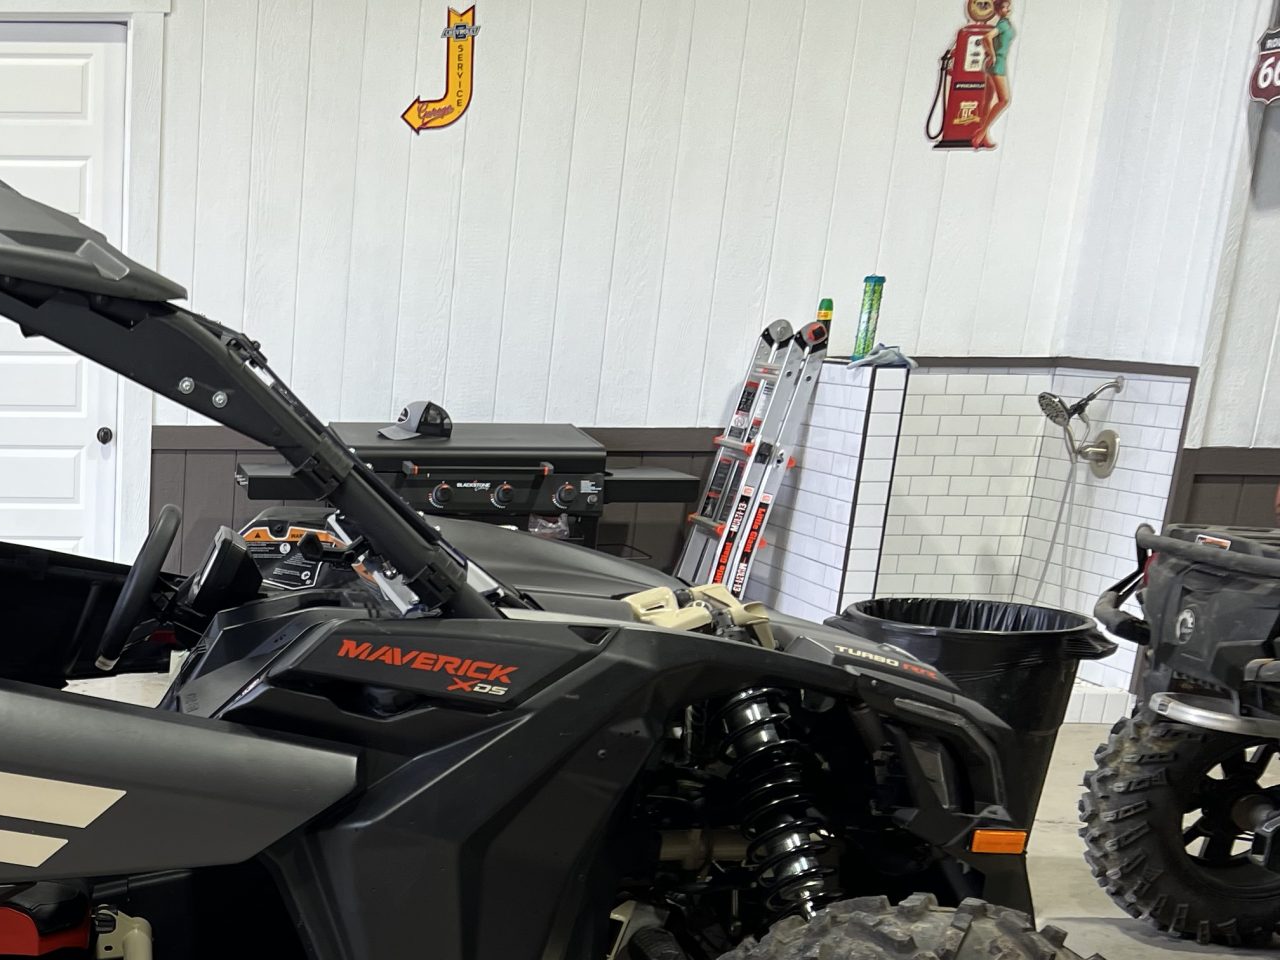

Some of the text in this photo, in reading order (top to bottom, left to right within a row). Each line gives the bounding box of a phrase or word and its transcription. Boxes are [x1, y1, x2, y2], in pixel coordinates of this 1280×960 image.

[456, 44, 464, 107] SERVICE
[337, 640, 519, 683] MAVERICK
[834, 645, 900, 667] TURBO
[447, 678, 509, 696] XDS
